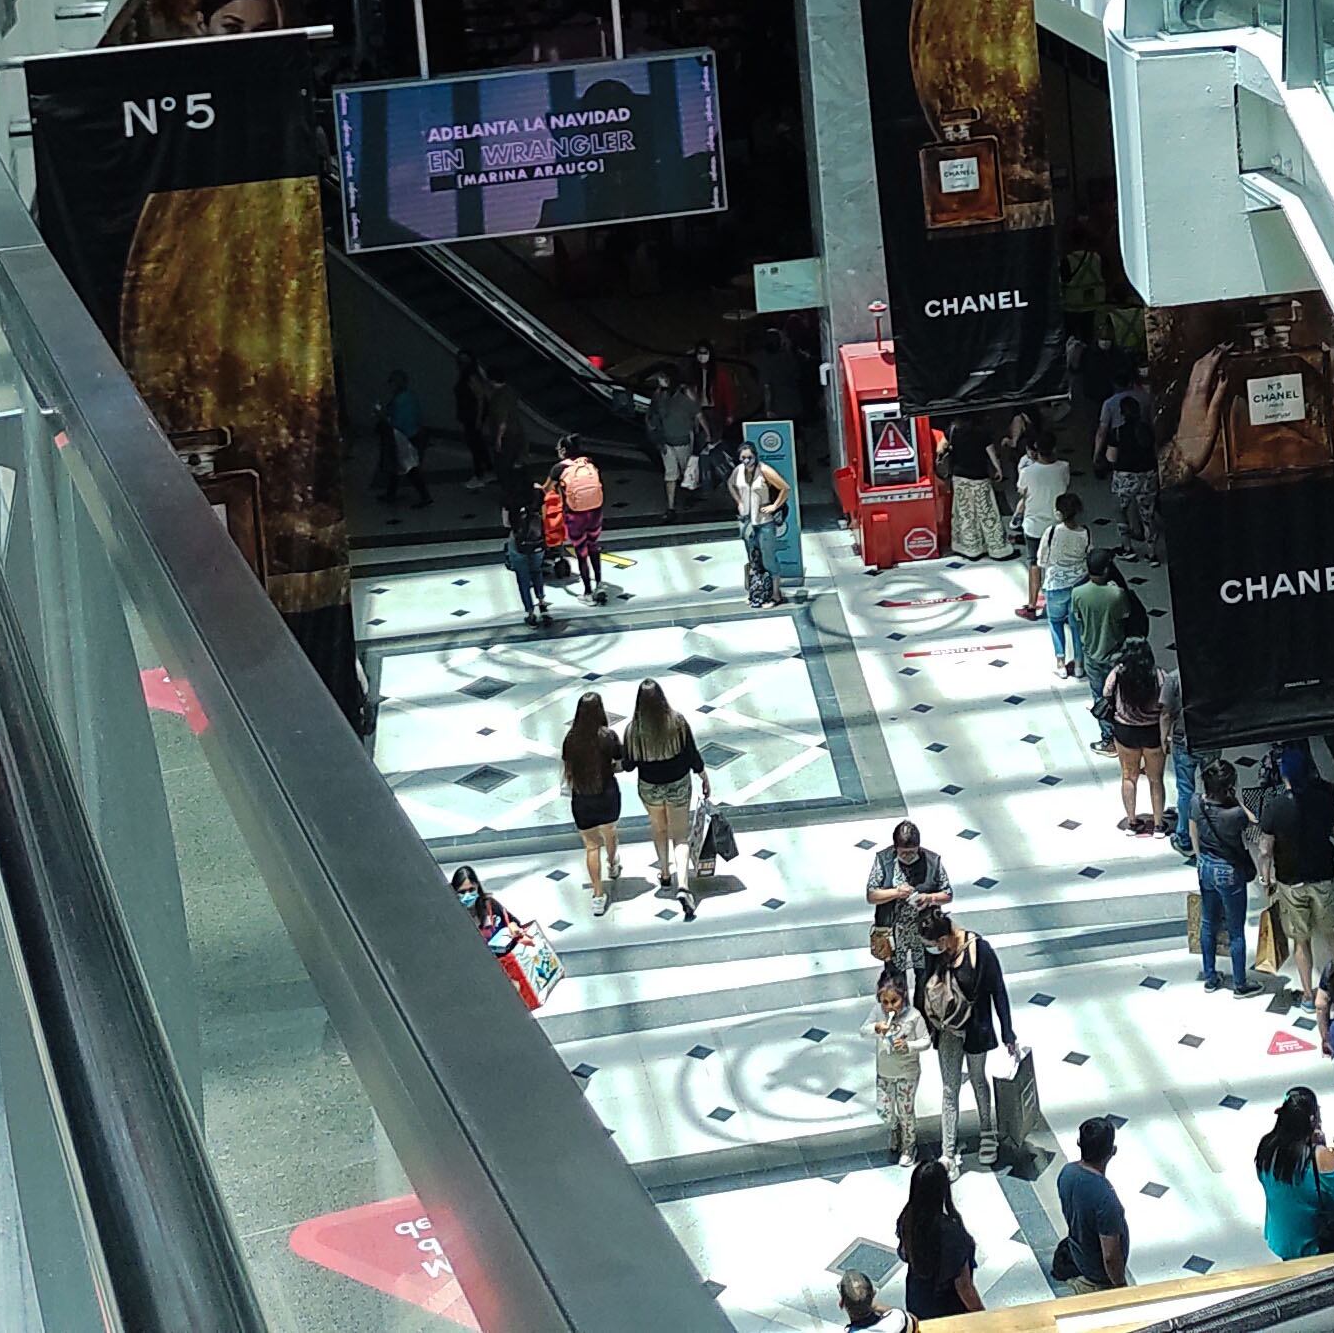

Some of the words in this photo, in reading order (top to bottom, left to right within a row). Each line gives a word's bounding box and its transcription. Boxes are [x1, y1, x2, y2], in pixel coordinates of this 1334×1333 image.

[428, 120, 517, 143] ADELANTA
[523, 115, 547, 132] LA
[550, 107, 631, 130] NAVIDAD
[427, 148, 465, 173] EN
[481, 130, 635, 166] WRANGLER
[924, 290, 1028, 318] CHANEL
[1253, 389, 1299, 403] CHANEL
